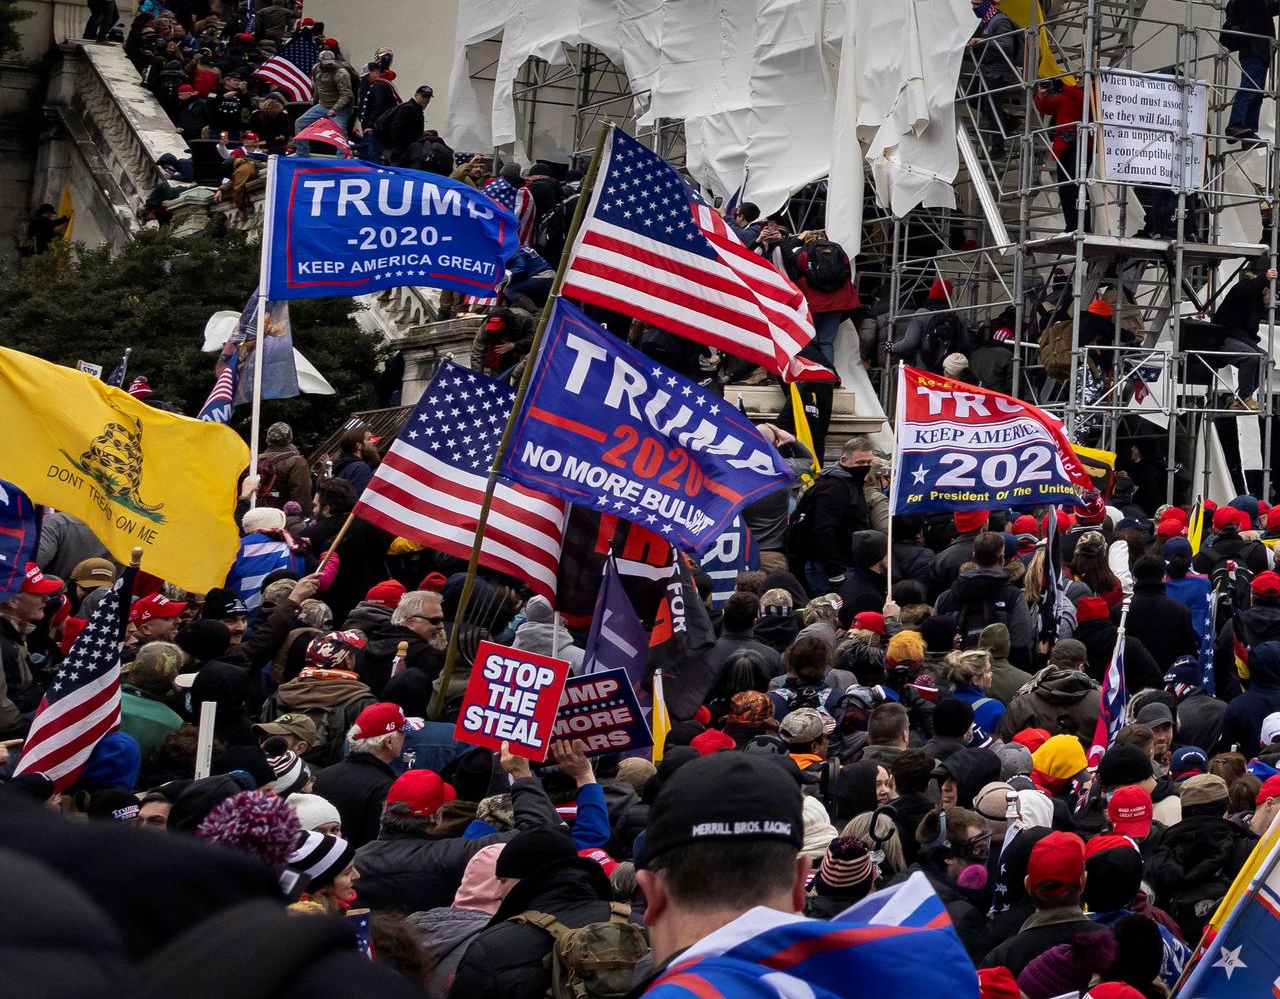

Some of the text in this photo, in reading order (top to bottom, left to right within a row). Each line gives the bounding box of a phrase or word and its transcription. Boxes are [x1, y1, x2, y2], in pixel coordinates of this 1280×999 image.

[1101, 74, 1127, 86] When
[1130, 77, 1145, 88] bad
[1147, 81, 1166, 91] men
[1102, 91, 1112, 102] he
[1115, 93, 1138, 105] good
[1140, 96, 1161, 107] must
[1102, 109, 1114, 120] lse
[1117, 110, 1136, 125] they
[1139, 113, 1155, 124] will
[1118, 130, 1129, 138] an
[1132, 131, 1167, 143] unpitied
[1114, 147, 1172, 160] contemptible
[298, 253, 496, 277] KEEP AMERICA GREAT!
[564, 332, 783, 477] TRUMP
[914, 427, 964, 444] KEEP
[601, 424, 704, 498] 2020
[521, 441, 563, 472] NO
[562, 454, 644, 502] MORE
[907, 494, 924, 504] For
[930, 490, 989, 501] President
[996, 491, 1009, 500] Of
[1013, 487, 1032, 497] The
[46, 465, 158, 545] DONT TREAD ON ME
[483, 655, 555, 691] STOP
[488, 682, 539, 717] THE
[385, 722, 395, 731] 45
[464, 705, 542, 748] STEAL
[692, 821, 792, 837] MERRILL BROS. RACING
